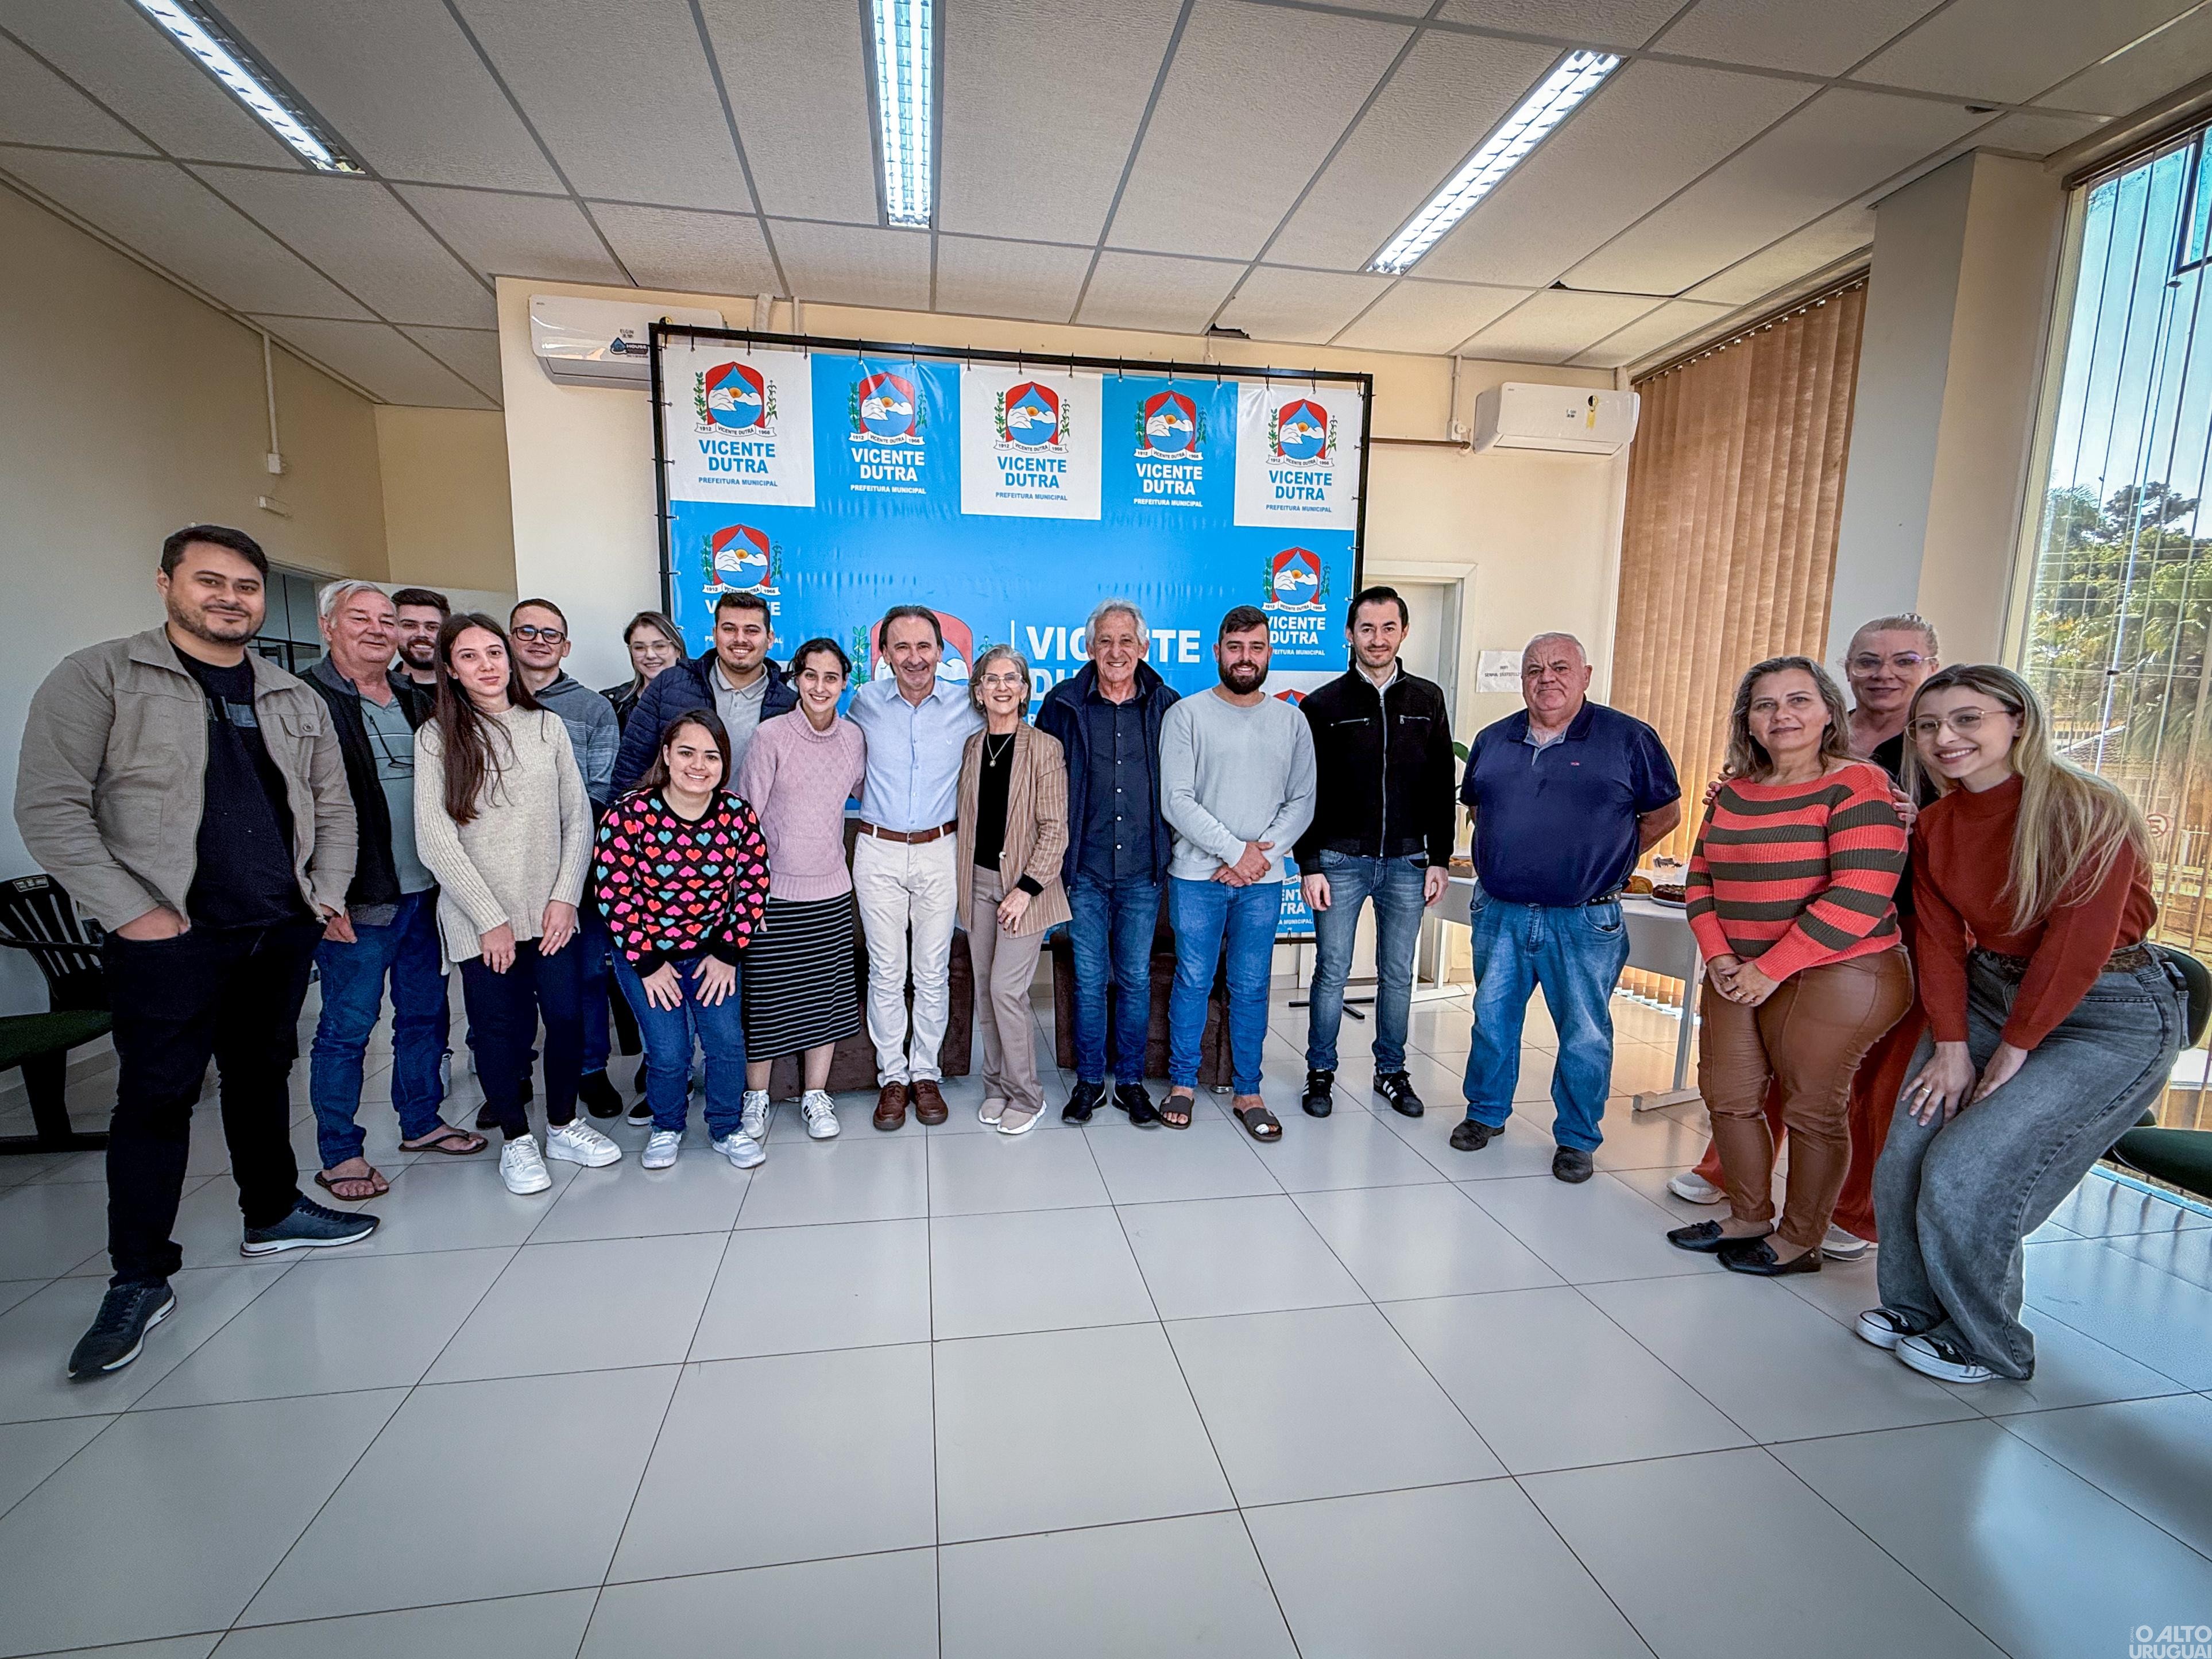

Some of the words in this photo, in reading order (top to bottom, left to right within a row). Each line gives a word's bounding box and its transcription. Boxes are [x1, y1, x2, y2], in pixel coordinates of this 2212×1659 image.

[718, 426, 737, 435] VICENTE
[870, 435, 888, 443] VICENTE
[698, 439, 776, 458] VICENTE
[1015, 443, 1032, 451] VICENTE
[851, 447, 925, 466] VICENTE
[1286, 457, 1302, 465] VICENTE
[708, 457, 768, 473] DUTRA
[997, 456, 1067, 473] VICENTE
[1135, 463, 1203, 480] VICENTE
[698, 477, 740, 485] PREFEITURA
[860, 465, 918, 482] DUTRA
[1005, 473, 1059, 488] DUTRA
[1269, 470, 1332, 486] VICENTE
[850, 484, 891, 493] PREFEITURA
[1143, 479, 1196, 495] DUTRA
[1275, 486, 1325, 501] DUTRA
[1026, 626, 1200, 663] VICTE
[1270, 631, 1318, 644] DUTRA
[1281, 902, 1306, 915] TRA
